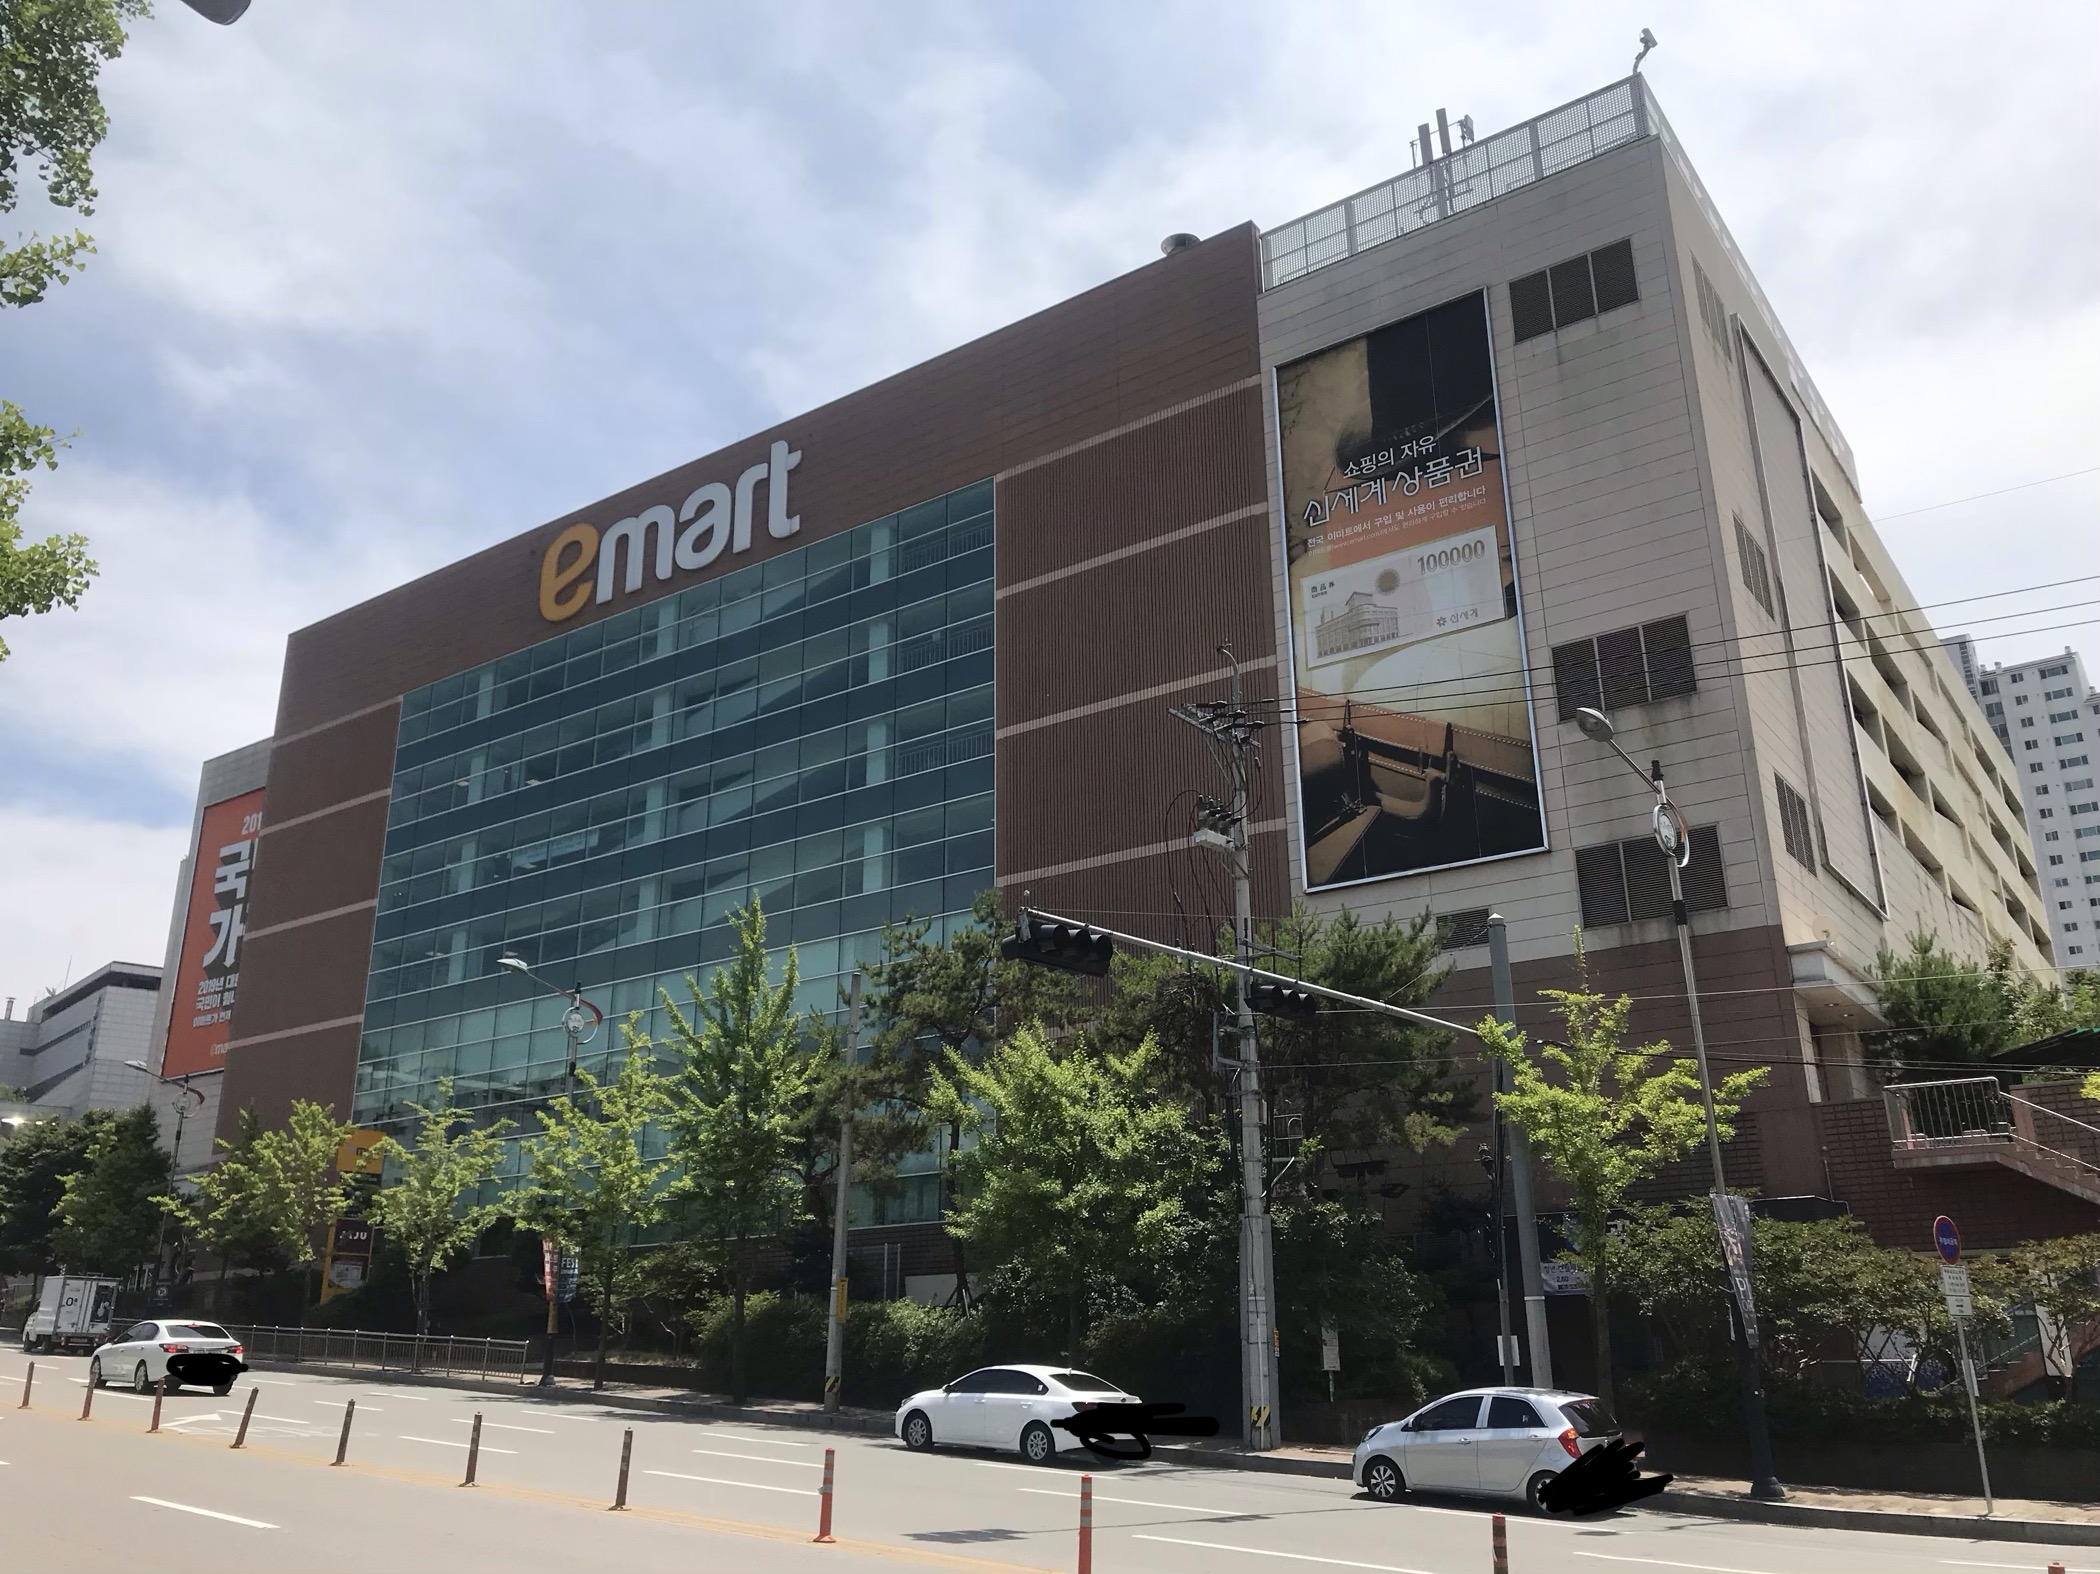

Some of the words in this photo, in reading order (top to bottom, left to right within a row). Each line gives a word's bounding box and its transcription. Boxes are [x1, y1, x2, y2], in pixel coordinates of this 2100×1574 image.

[1303, 477, 1388, 527] 신세계
[1391, 446, 1483, 496] 상품권
[1343, 447, 1395, 479] 쇼핑의
[1400, 435, 1437, 459] 자유
[539, 440, 802, 622] emart
[1307, 535, 1325, 548] 전국
[1327, 520, 1371, 541] 이마트에서
[1374, 513, 1392, 528] 구입
[1395, 509, 1405, 521] 및
[1407, 501, 1435, 517] 사용이
[1438, 484, 1487, 508] 편리합니다
[1417, 540, 1485, 575] 100000
[214, 839, 259, 899] 국
[203, 903, 249, 968] 가
[198, 976, 225, 995] 2019년
